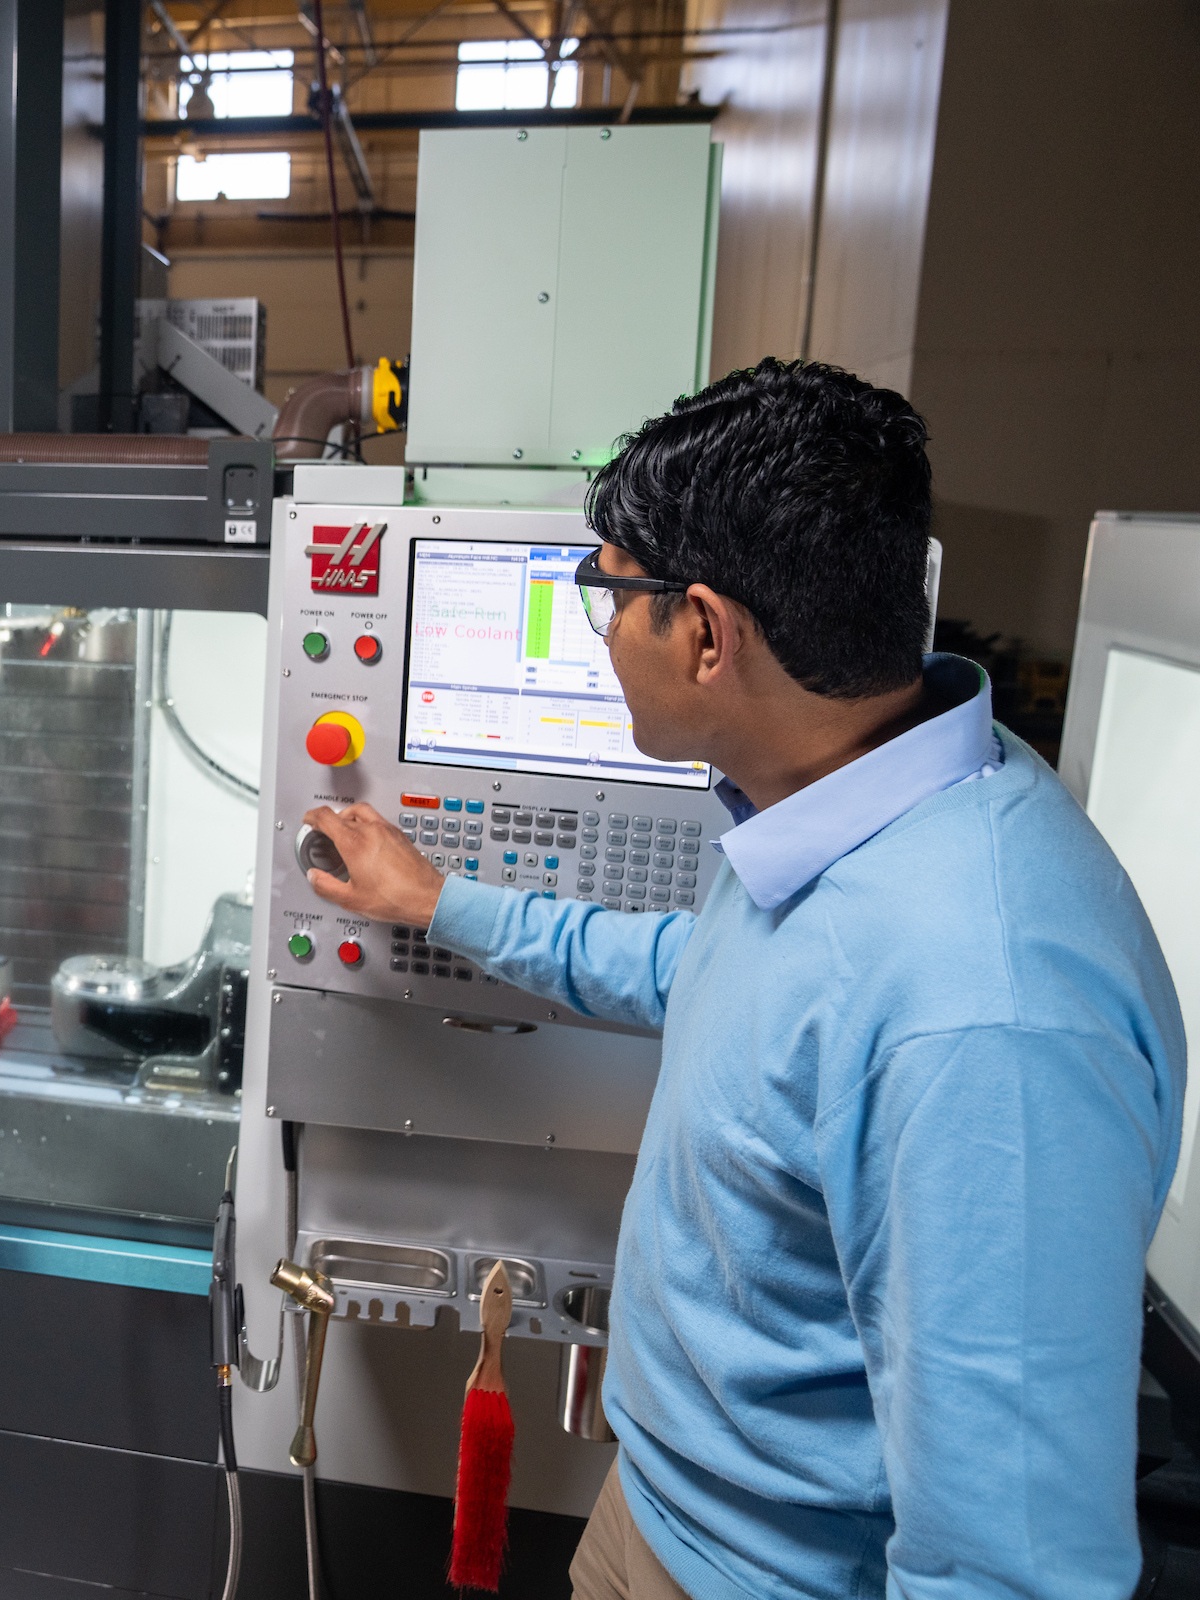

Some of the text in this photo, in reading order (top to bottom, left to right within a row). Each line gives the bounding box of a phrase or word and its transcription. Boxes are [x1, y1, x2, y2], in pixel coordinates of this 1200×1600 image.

[311, 568, 377, 588] HAAS
[300, 609, 322, 617] POWER
[430, 604, 507, 621] Safe Run
[415, 621, 522, 641] Low Coolant
[311, 692, 350, 700] EMERGENCY
[314, 794, 355, 804] HANDLE JOG
[410, 798, 430, 806] RESET
[283, 910, 323, 921] CYCLE START
[336, 917, 370, 927] FEED HOLD
